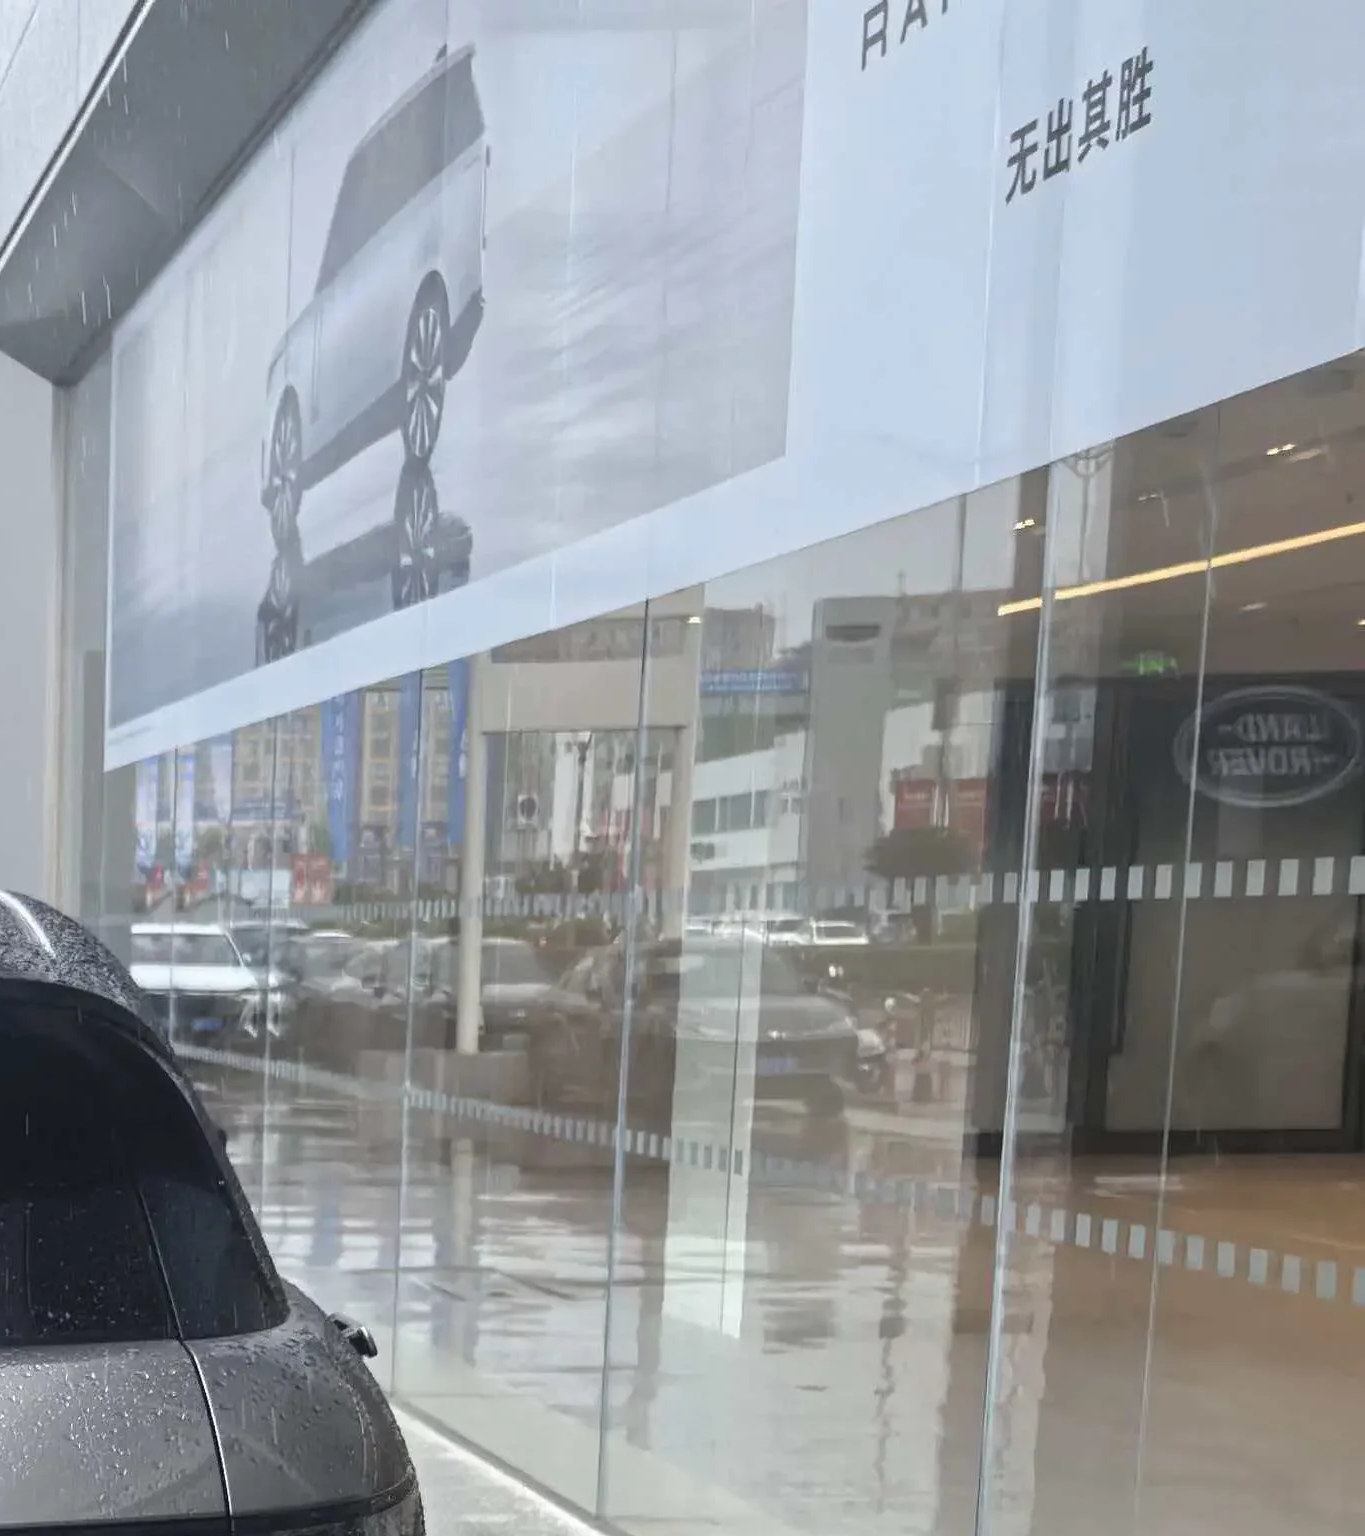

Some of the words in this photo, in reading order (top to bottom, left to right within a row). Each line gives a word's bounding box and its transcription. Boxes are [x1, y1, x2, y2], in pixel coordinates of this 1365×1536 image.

[861, 0, 950, 71] RA
[1005, 46, 1153, 206] 无出其胜
